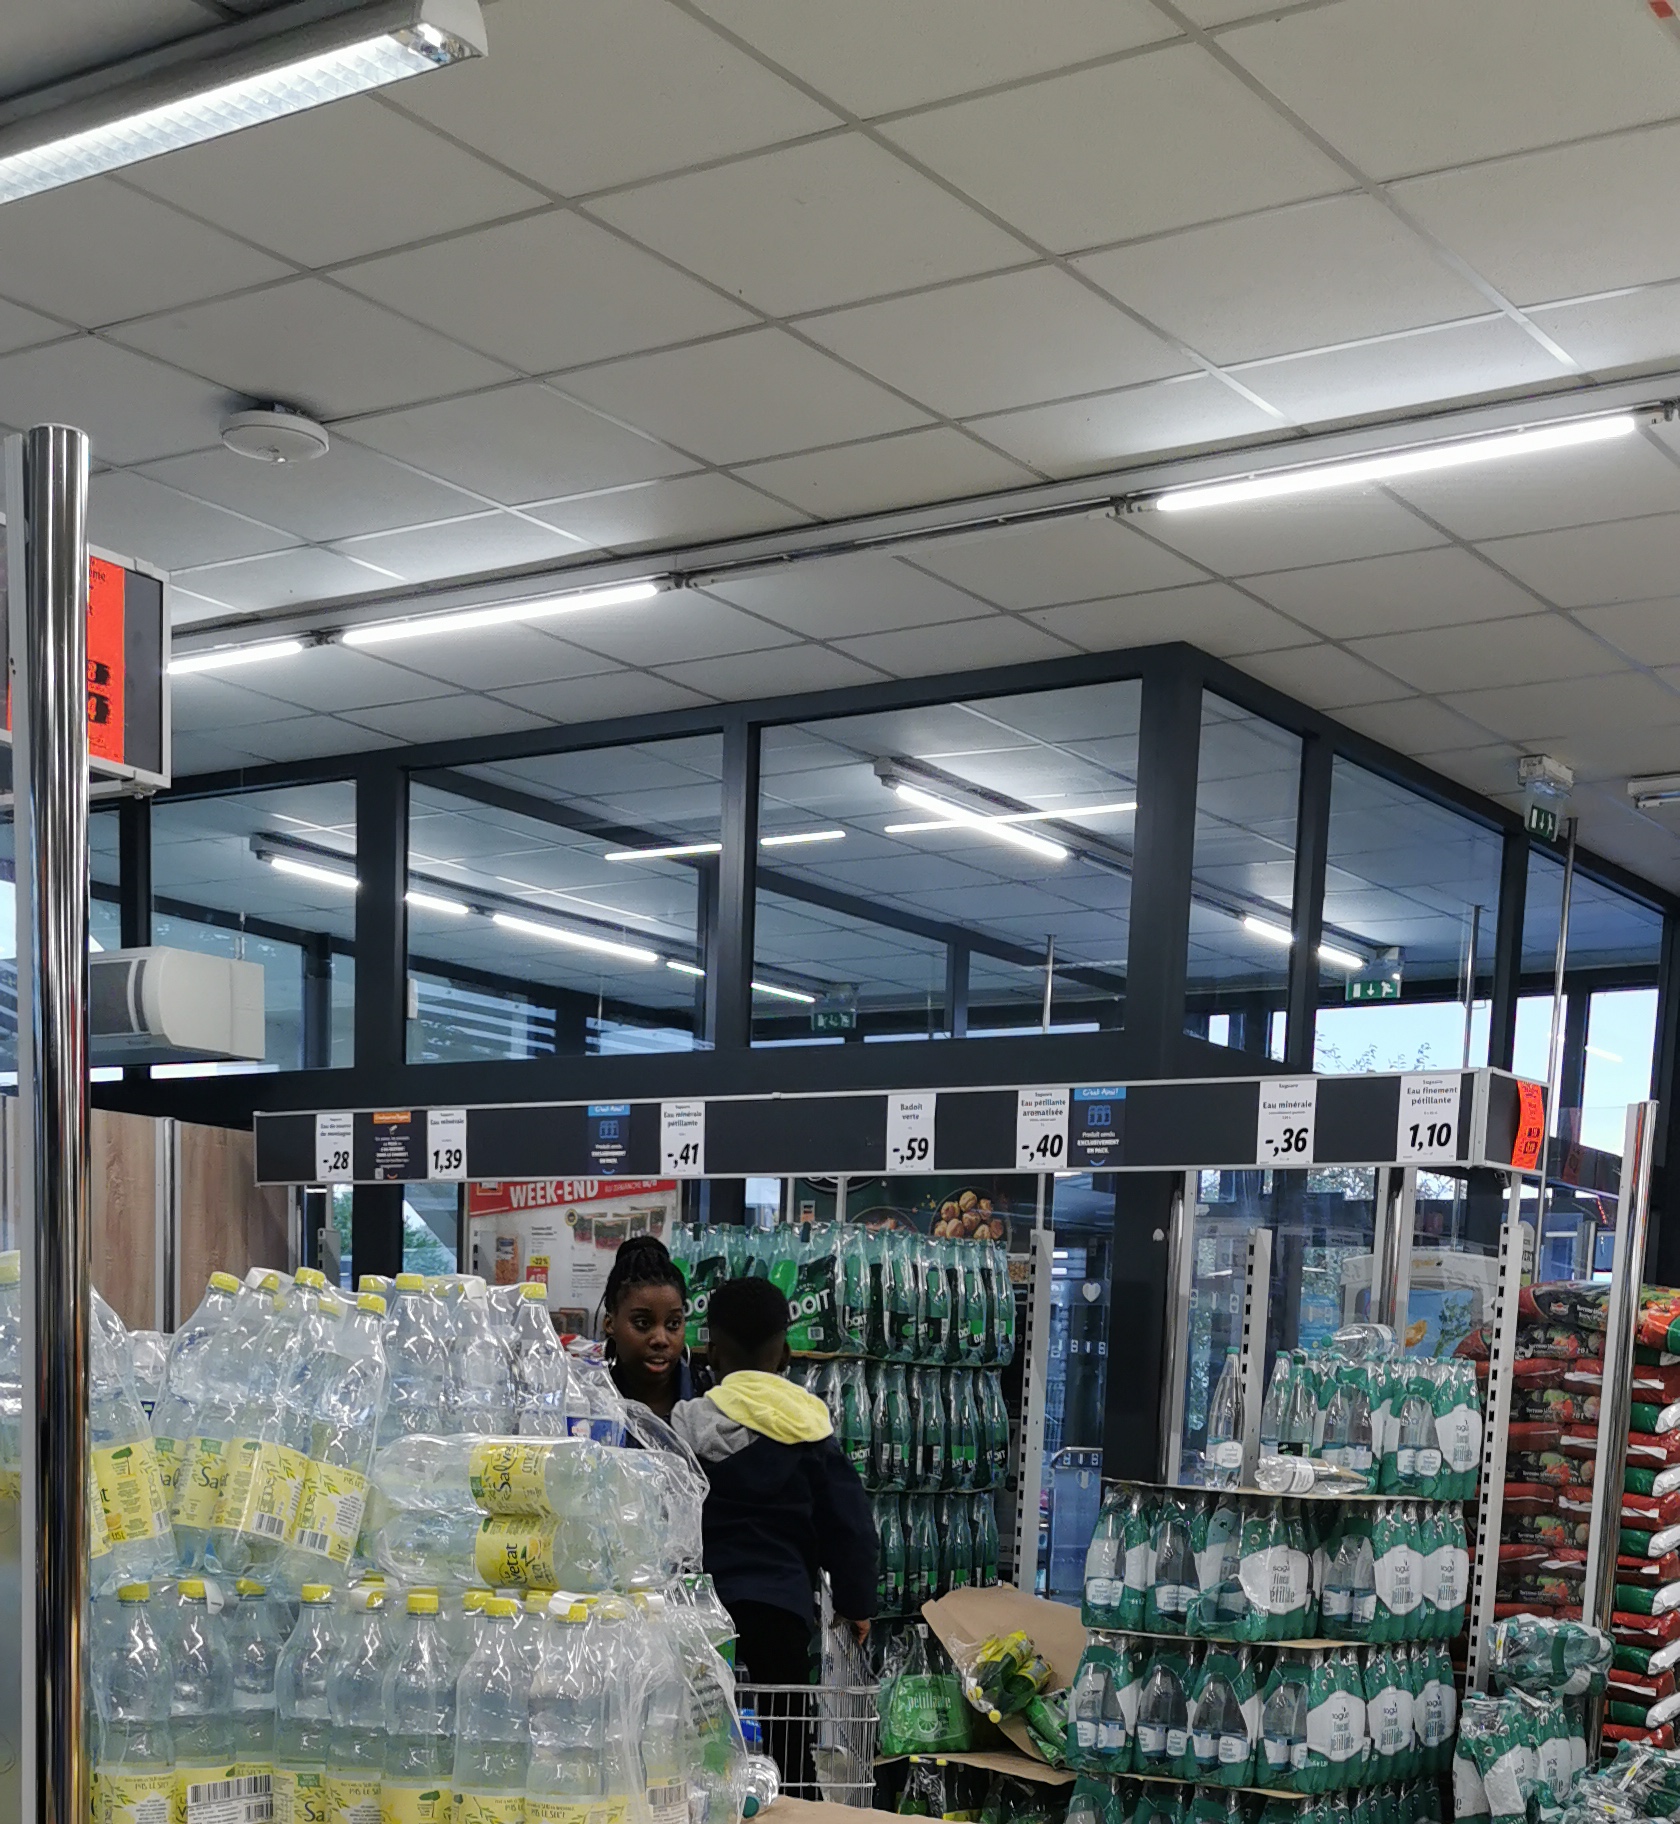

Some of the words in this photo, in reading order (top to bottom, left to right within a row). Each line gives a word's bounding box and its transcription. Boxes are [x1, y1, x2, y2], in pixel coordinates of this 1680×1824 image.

[1411, 1097, 1452, 1106] pétillante
[1422, 1087, 1457, 1095] finement
[900, 1103, 923, 1111] Badoit
[1021, 1099, 1032, 1107] Eau
[1034, 1098, 1066, 1108] pétillante
[1022, 1108, 1063, 1117] aromatisée
[1279, 1100, 1312, 1108] minérale
[1021, 1134, 1063, 1161] -,40
[1265, 1127, 1309, 1157] -,36
[1409, 1122, 1452, 1151] 1,10
[323, 1151, 350, 1173] -,28
[433, 1148, 463, 1173] 1,39
[667, 1142, 699, 1168] -,41
[892, 1138, 929, 1164] -,59
[509, 1180, 600, 1208] WEEK-END
